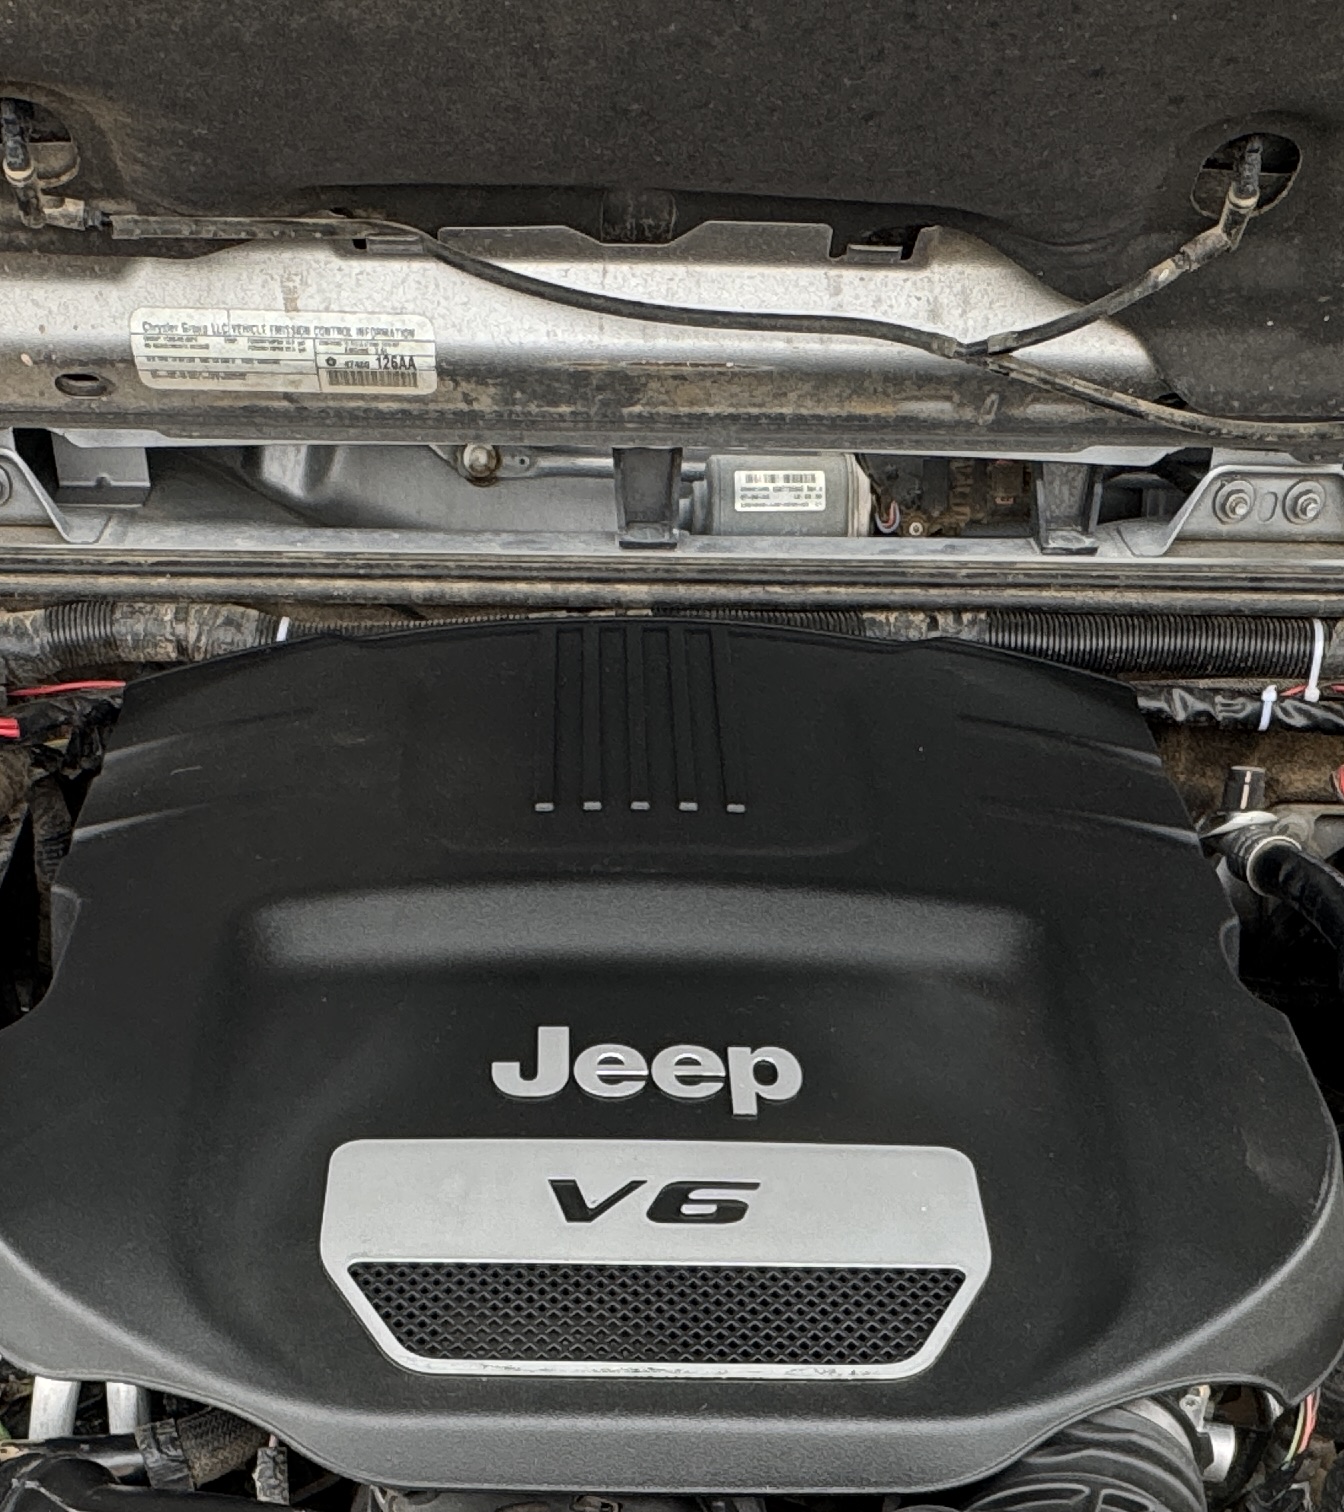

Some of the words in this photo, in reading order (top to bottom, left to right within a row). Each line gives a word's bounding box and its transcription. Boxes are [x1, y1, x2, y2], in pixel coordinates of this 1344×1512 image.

[212, 323, 229, 335] LLC
[375, 355, 417, 371] 126AA
[492, 1025, 804, 1117] Jeep
[548, 1179, 761, 1224] V6
